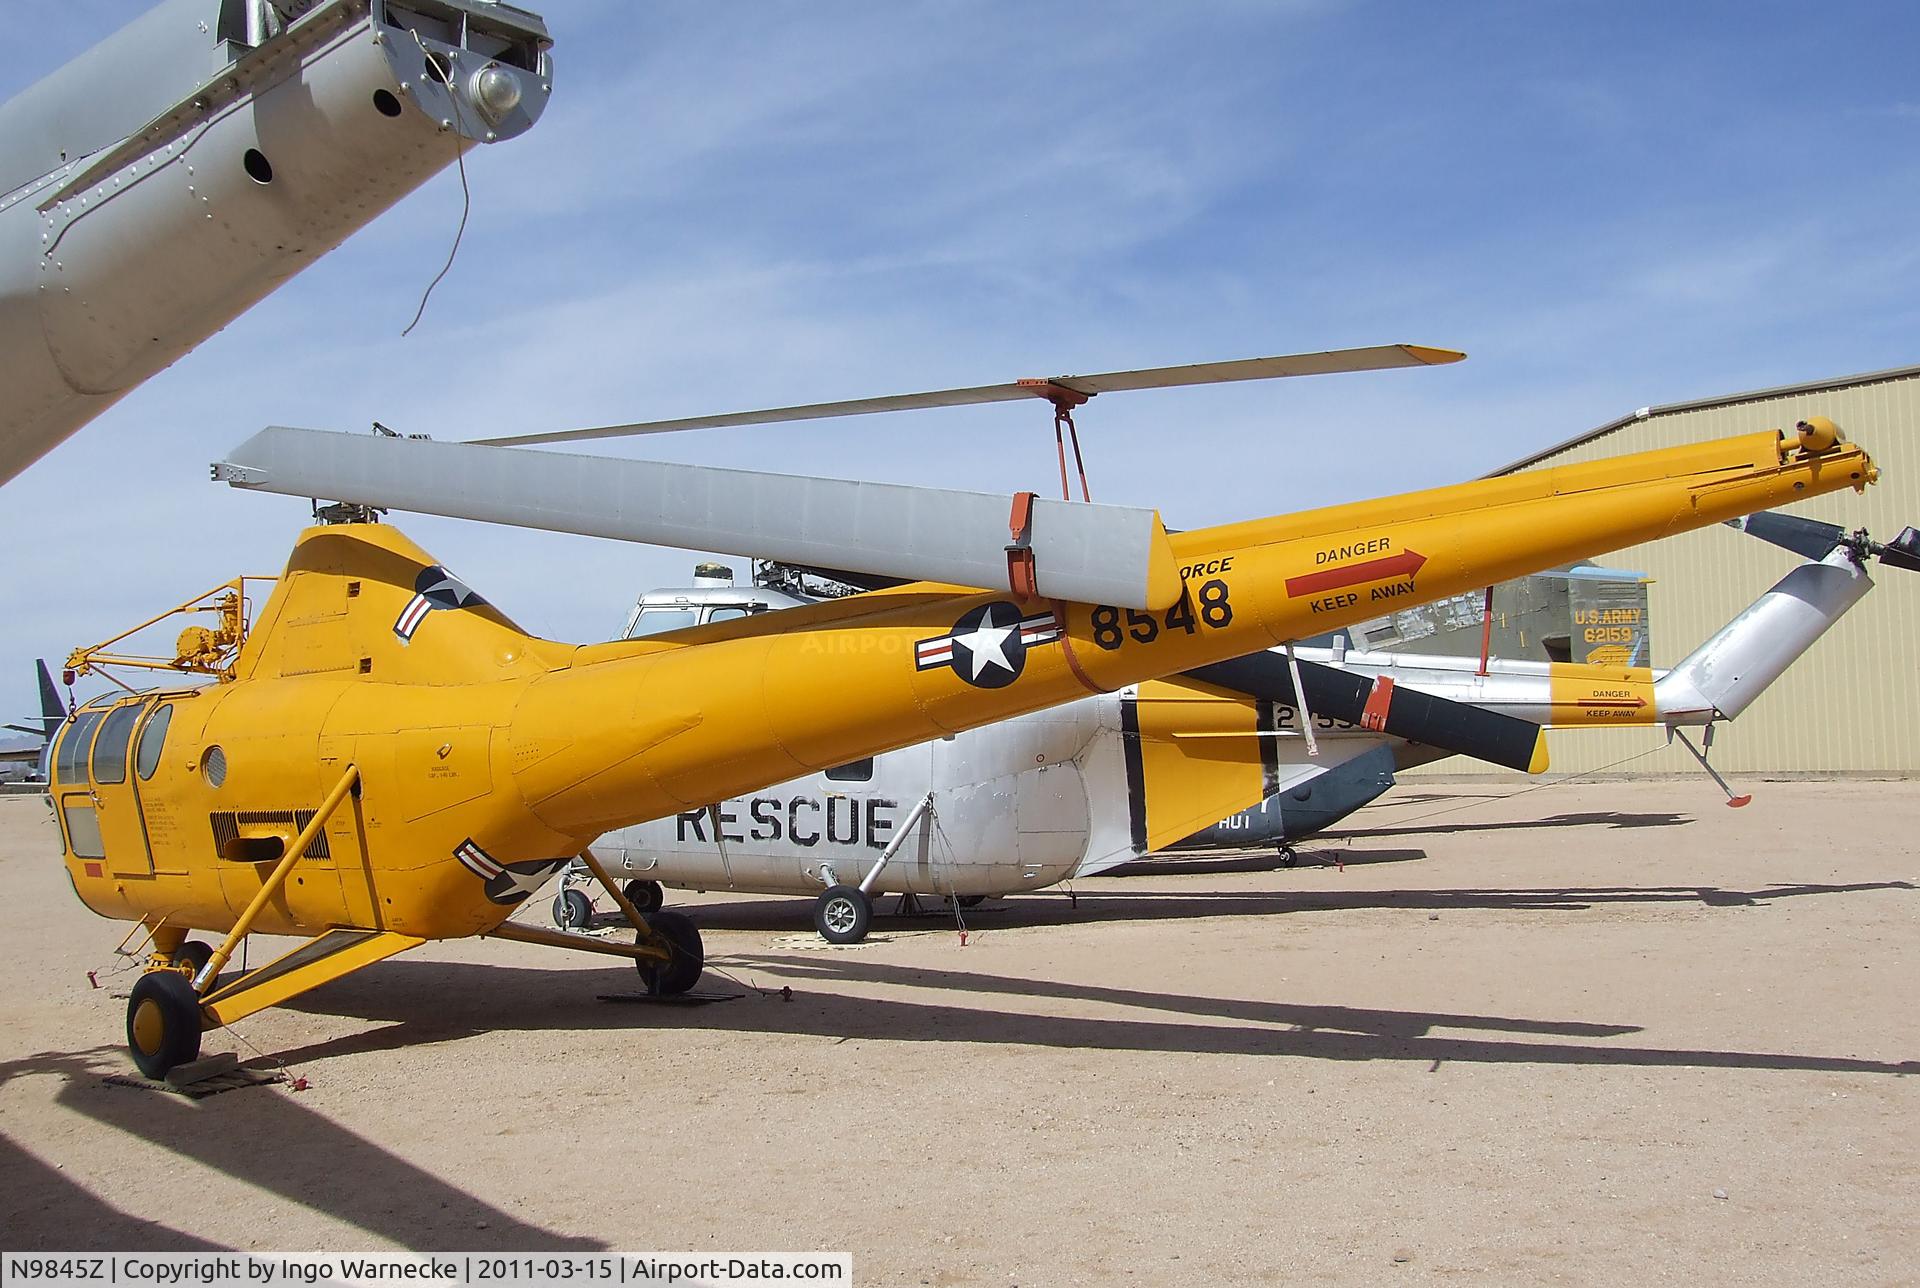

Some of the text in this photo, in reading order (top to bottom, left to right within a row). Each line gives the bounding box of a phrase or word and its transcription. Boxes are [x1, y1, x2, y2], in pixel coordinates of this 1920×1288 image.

[1315, 537, 1391, 565] DANGER
[1180, 556, 1234, 580] ORCE
[1310, 580, 1416, 614] KEEP AWAY
[1091, 578, 1234, 651] 8548
[1584, 626, 1633, 643] 62159
[1592, 690, 1631, 698] DANGER
[1586, 710, 1637, 718] KEEP AWAY
[676, 795, 899, 850] RESCUE
